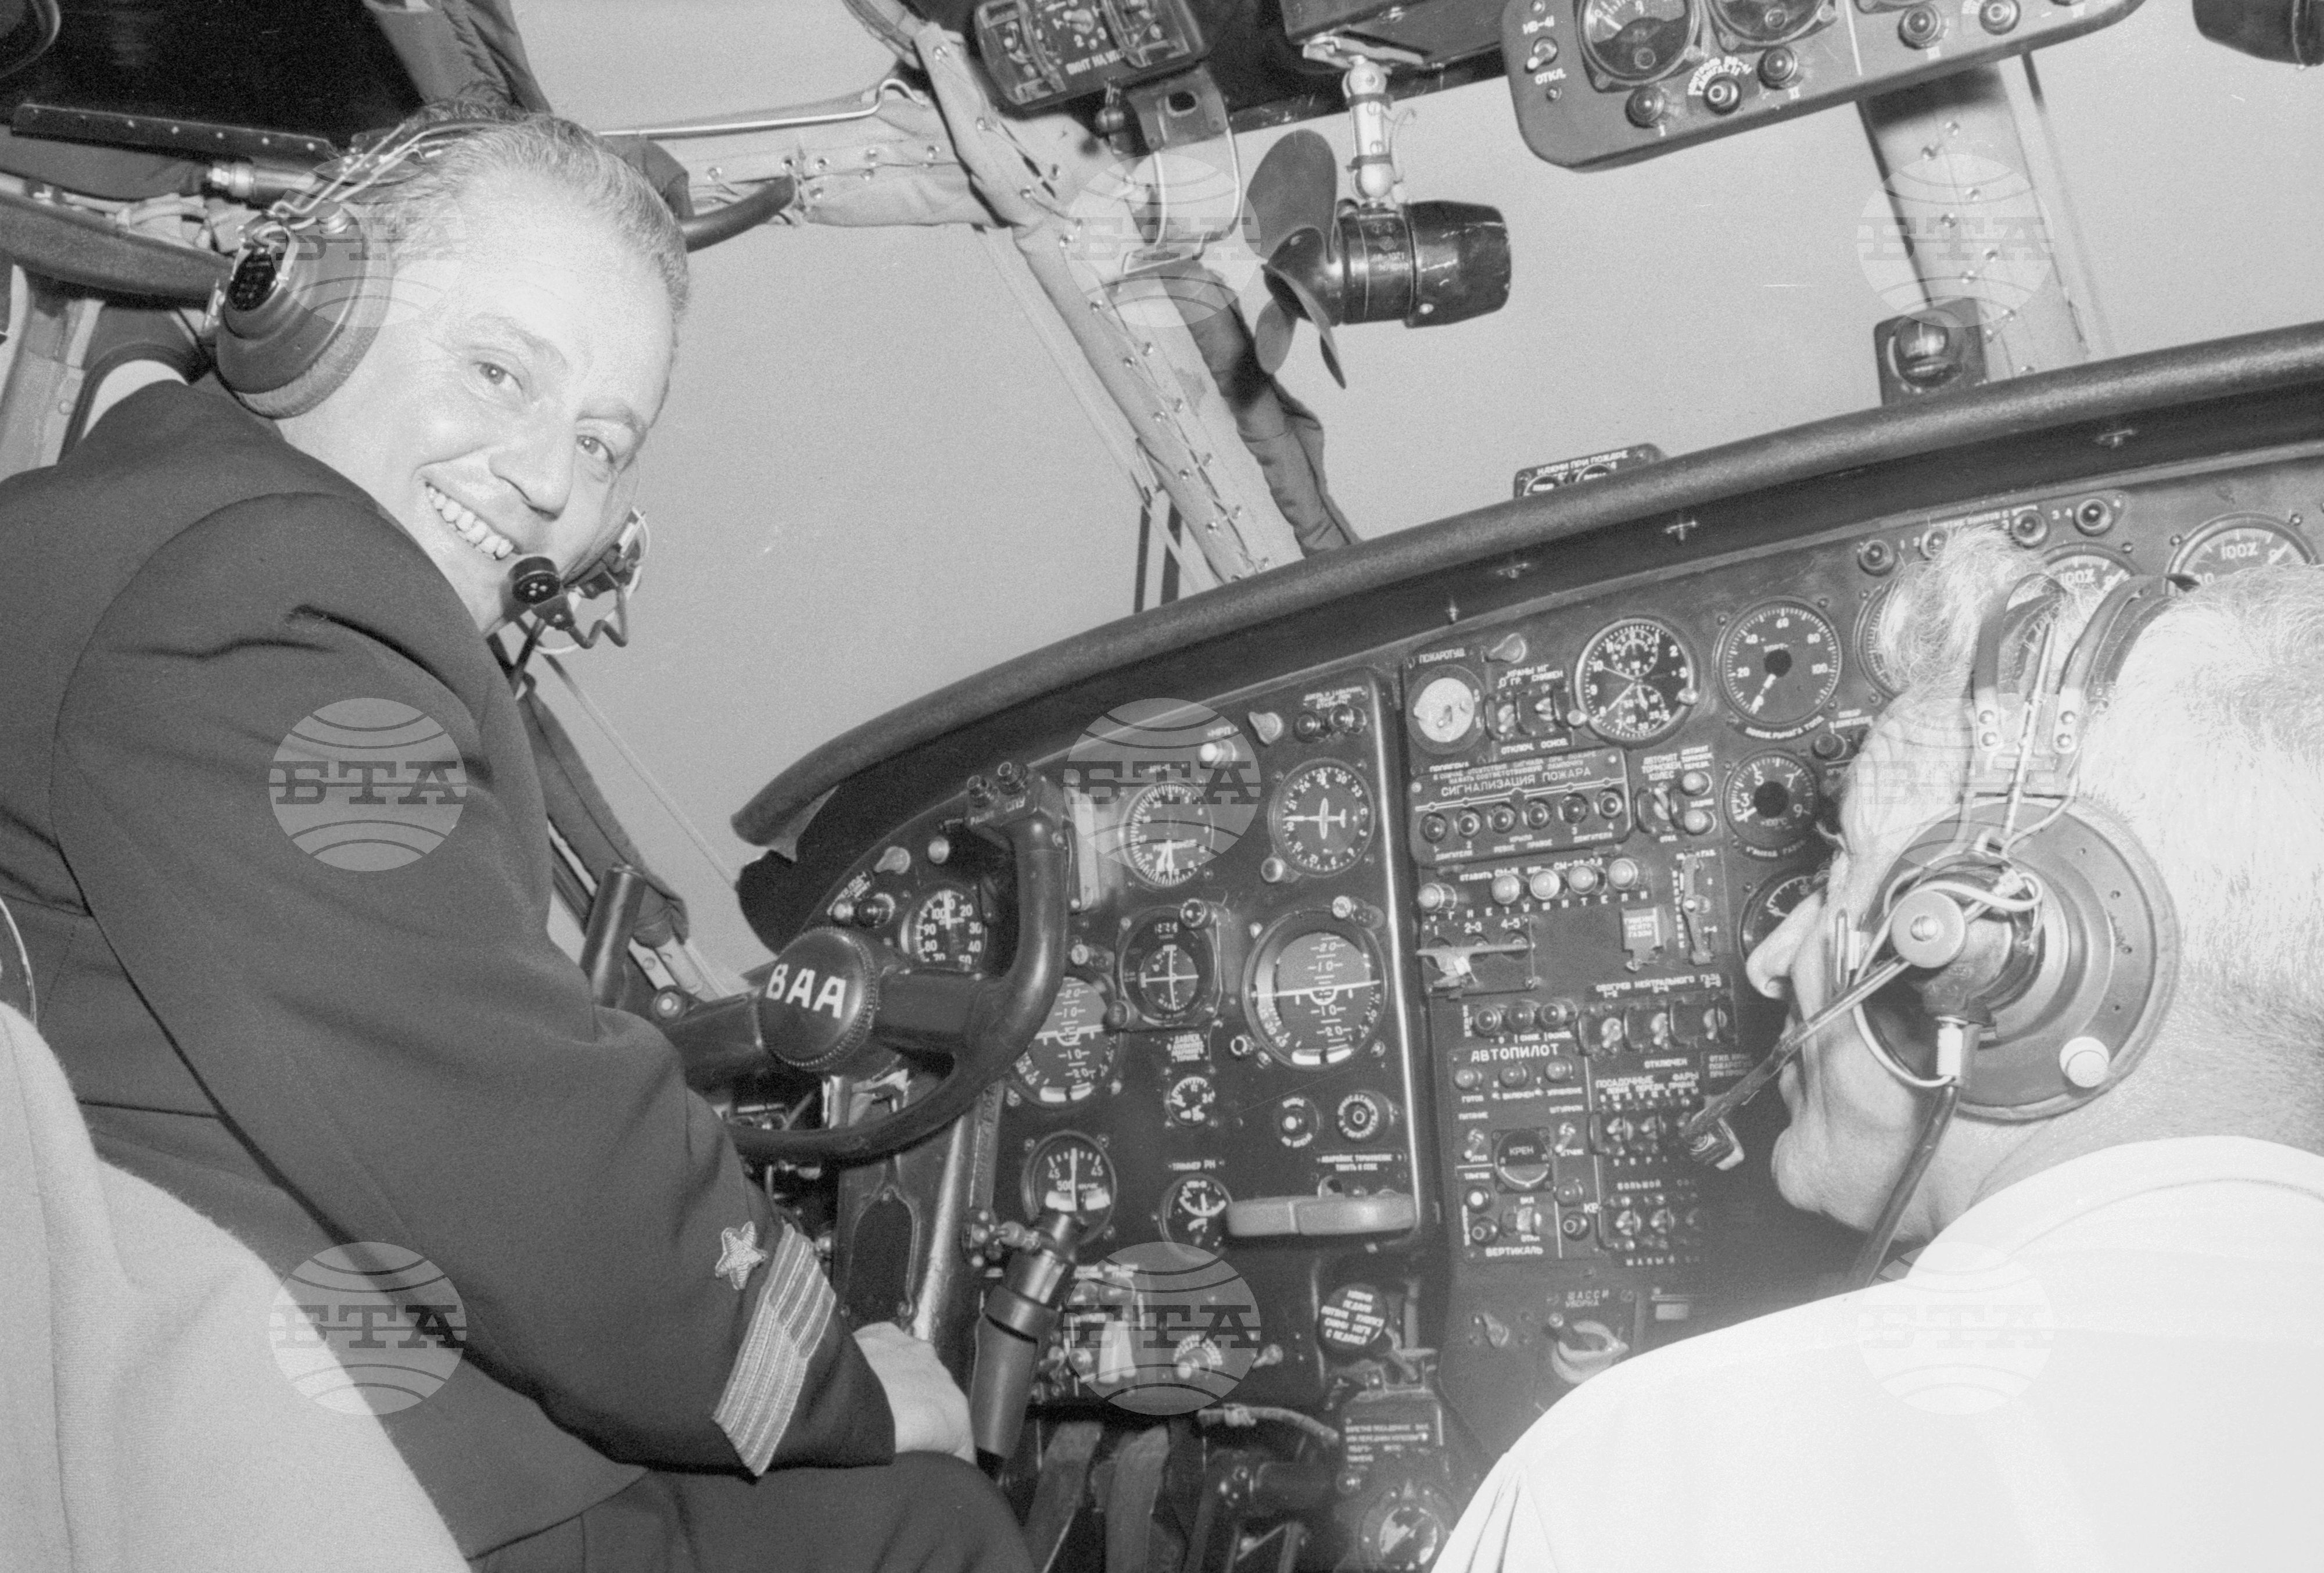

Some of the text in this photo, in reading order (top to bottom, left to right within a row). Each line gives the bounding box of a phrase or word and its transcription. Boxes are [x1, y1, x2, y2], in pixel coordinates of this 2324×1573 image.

[2221, 541, 2258, 560] 100%
[1441, 767, 1591, 797] СИГНАЛИЗАЦИЯ ПОЖАРА
[960, 905, 973, 918] 20
[924, 923, 937, 936] 90
[970, 922, 982, 934] 30
[924, 940, 938, 952] 80
[967, 940, 981, 952] 40
[1471, 1043, 1559, 1062] АВТОПИЛОТ
[1509, 1145, 1534, 1156] КРЕН
[1048, 1169, 1061, 1180] 45
[1091, 1166, 1103, 1177] 45
[1485, 1246, 1544, 1258] ВЕРТИКАЛЬ
